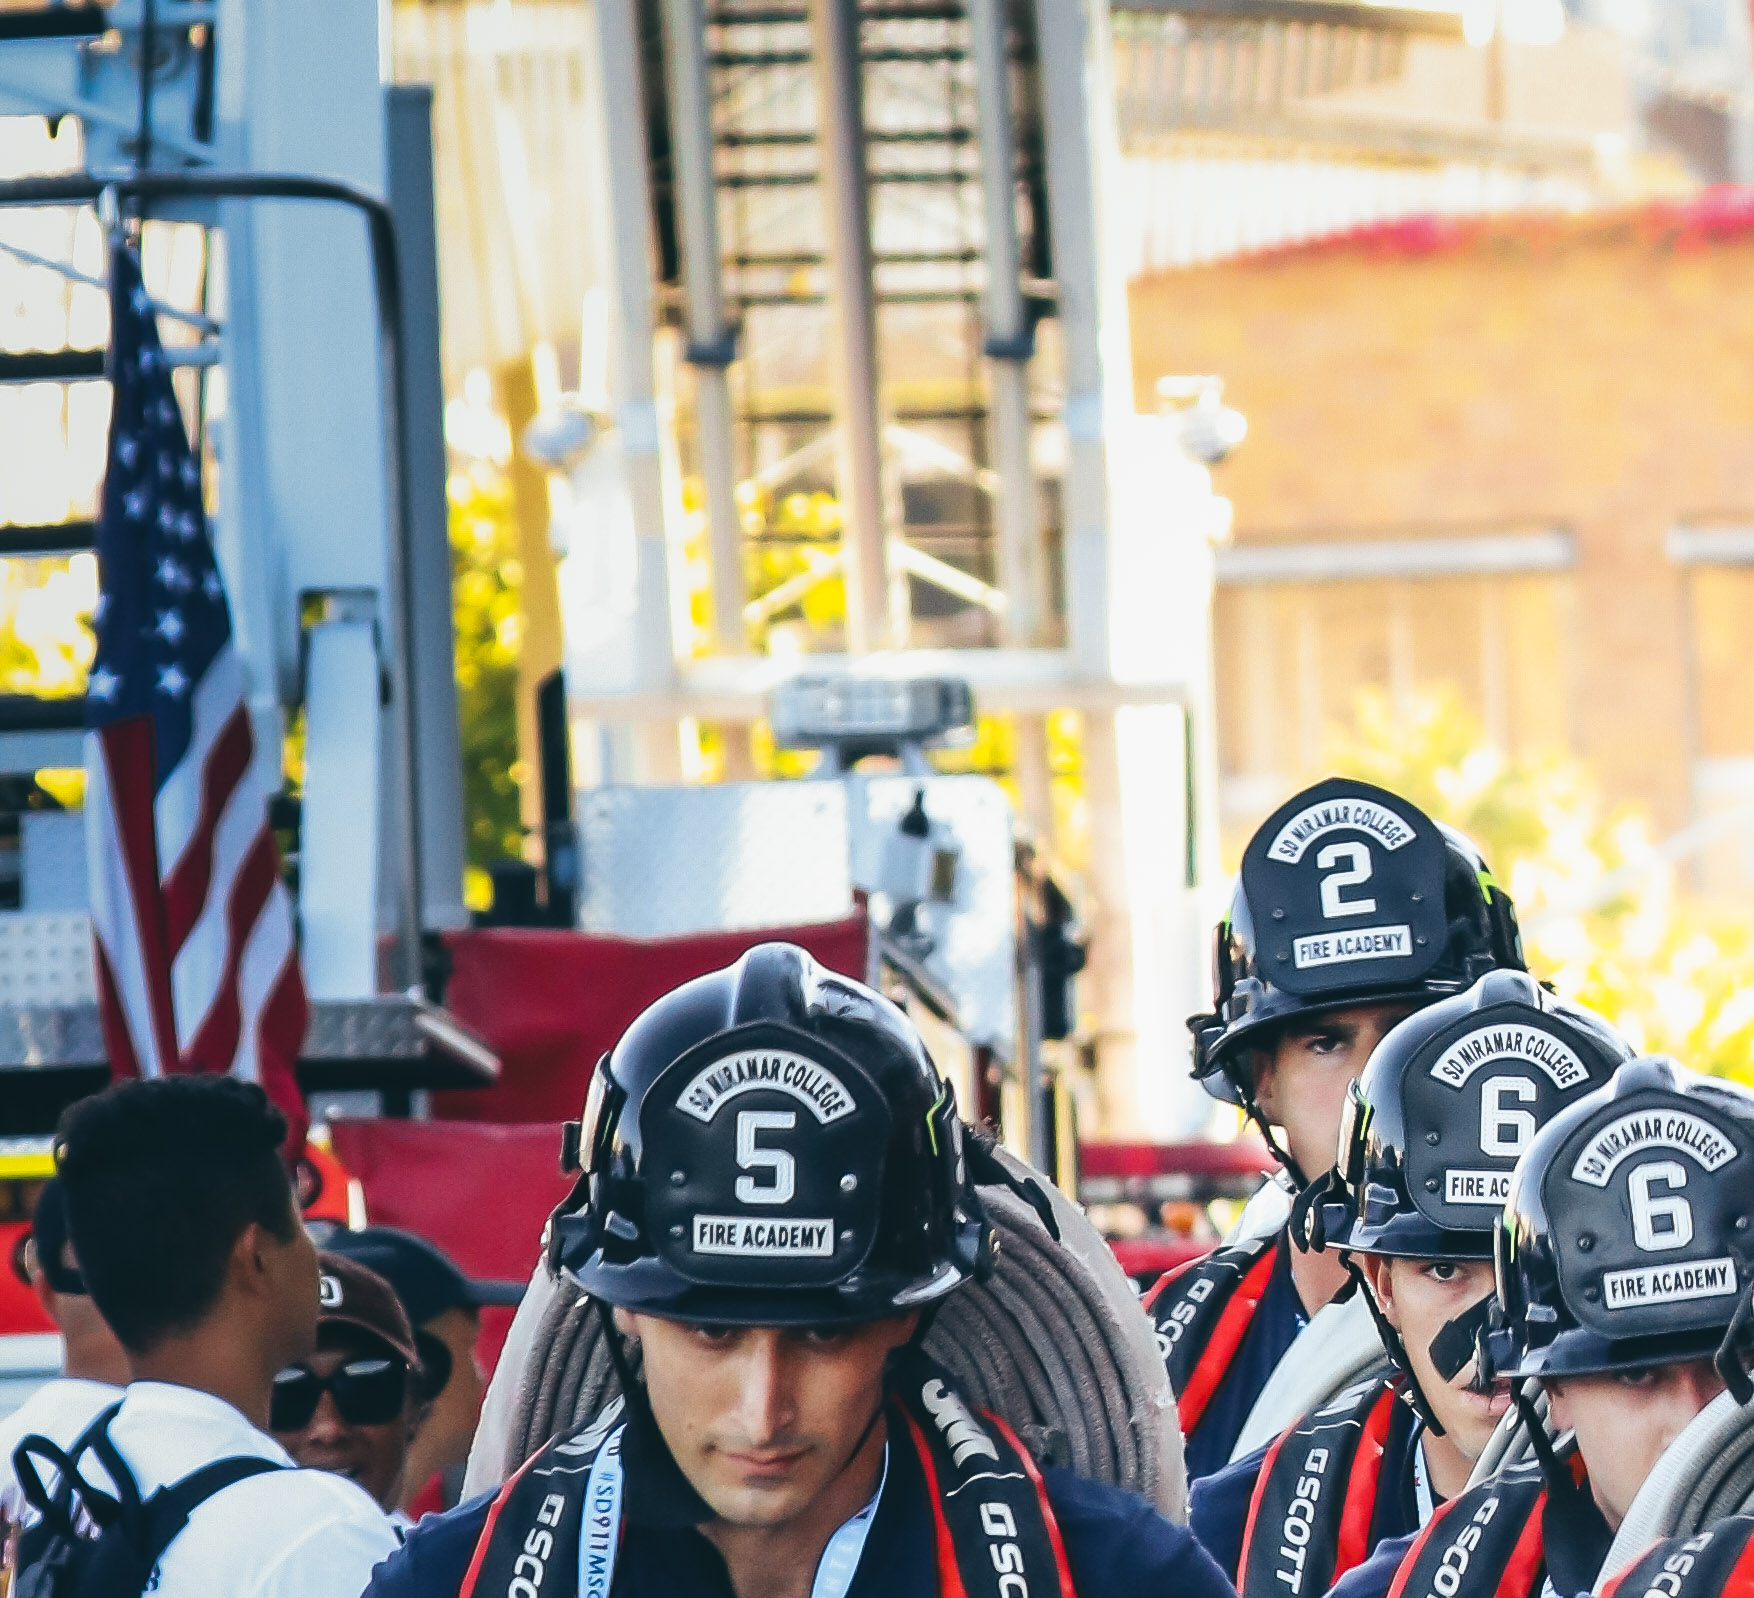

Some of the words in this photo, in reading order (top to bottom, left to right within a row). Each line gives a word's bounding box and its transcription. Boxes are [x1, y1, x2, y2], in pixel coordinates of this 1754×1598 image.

[1291, 805, 1350, 842] MIRAMAR
[1354, 806, 1407, 847] COLLEGE
[1316, 841, 1377, 919] 2
[1300, 941, 1331, 962] FIRE
[1336, 932, 1403, 956] ACADEMY
[1457, 1031, 1523, 1067] MIRAMAR
[1525, 1034, 1580, 1084] COLLEGE
[705, 1056, 780, 1094] MIRAMAR
[783, 1060, 846, 1118] COLLEGE
[1480, 1075, 1537, 1158] 6
[1595, 1117, 1662, 1163] MIRAMAR
[1666, 1117, 1728, 1167] COLLEGE
[735, 1110, 797, 1205] 5
[1451, 1176, 1485, 1198] FIRE
[1628, 1160, 1695, 1252] 6
[699, 1223, 737, 1246] FIRE
[741, 1223, 827, 1249] ACADEMY
[1610, 1276, 1647, 1301] FIRE
[1652, 1264, 1728, 1297] ACADEMY
[1275, 1475, 1321, 1595] SCOTT
